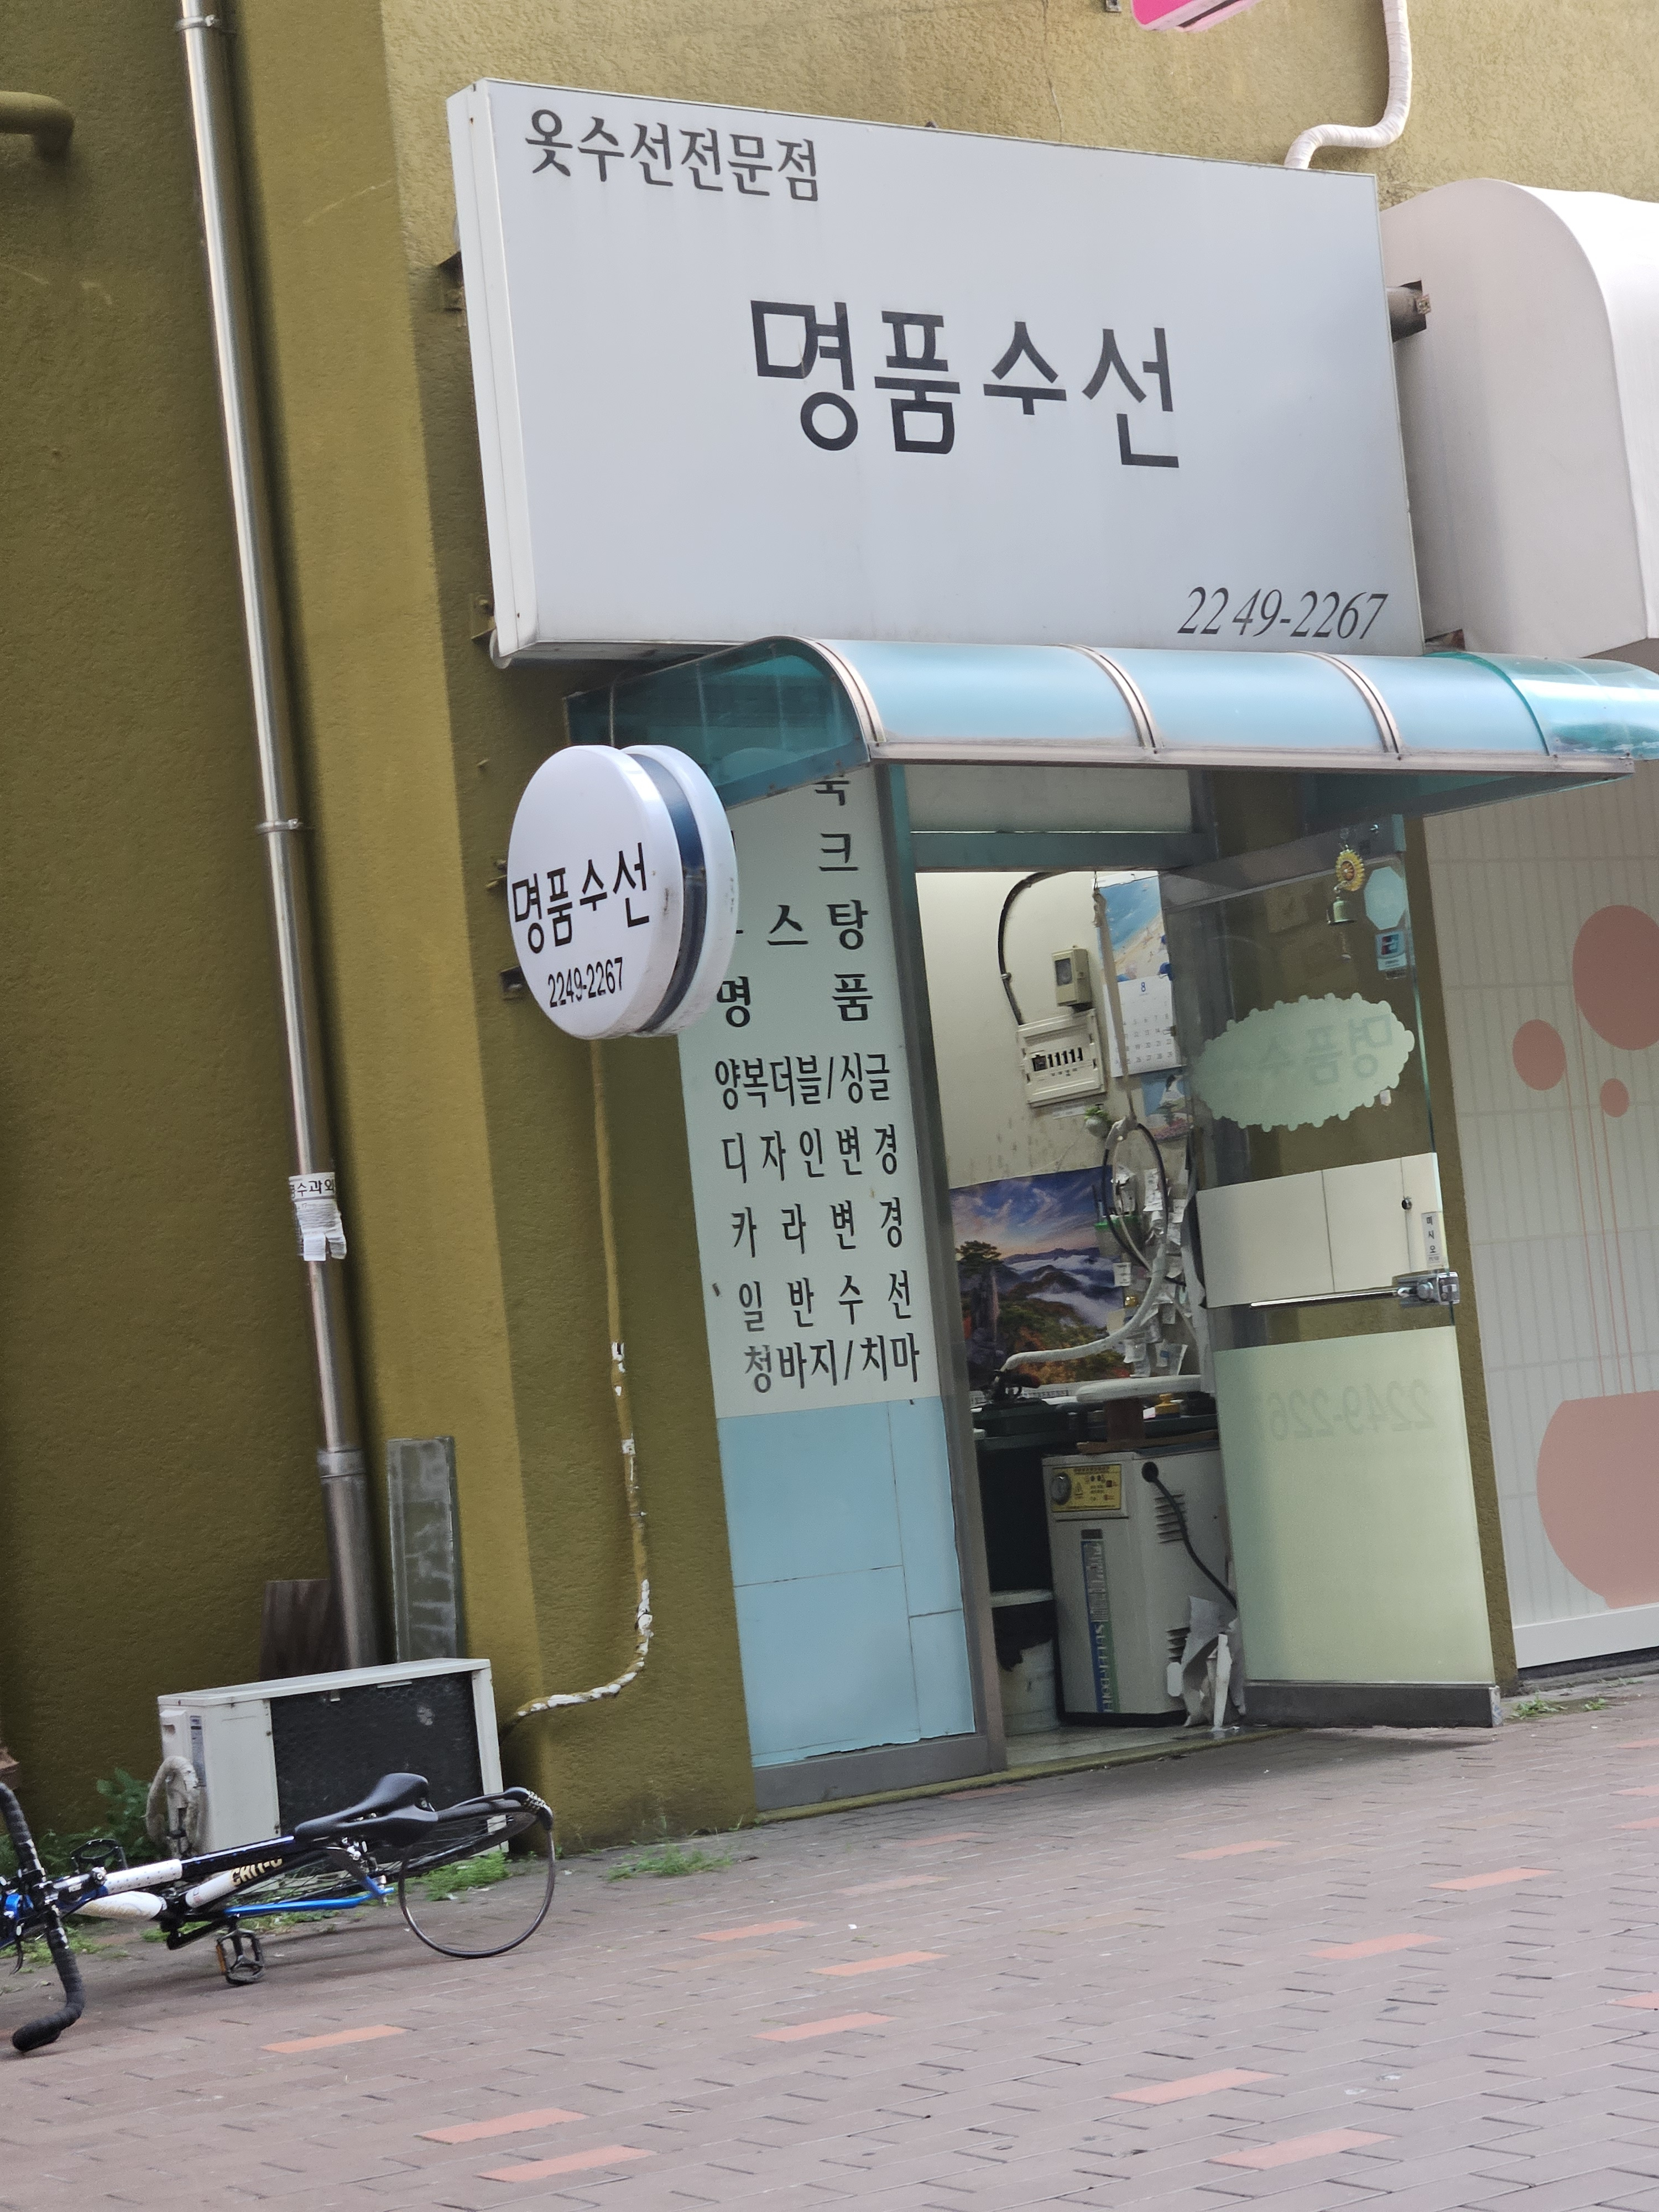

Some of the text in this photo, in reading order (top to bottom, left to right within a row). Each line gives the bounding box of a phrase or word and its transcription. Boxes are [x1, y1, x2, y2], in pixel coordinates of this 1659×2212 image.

[525, 109, 818, 201] 옷수선전문점
[750, 300, 1180, 468] 명품수선
[1177, 587, 1389, 640] 2249-2267
[512, 842, 649, 954] 명품수선
[548, 957, 623, 1008] 2249-2267
[1141, 982, 1146, 992] 8
[715, 1052, 890, 1110] 양복더블/싱글
[744, 1333, 920, 1393] 청바지/치마
